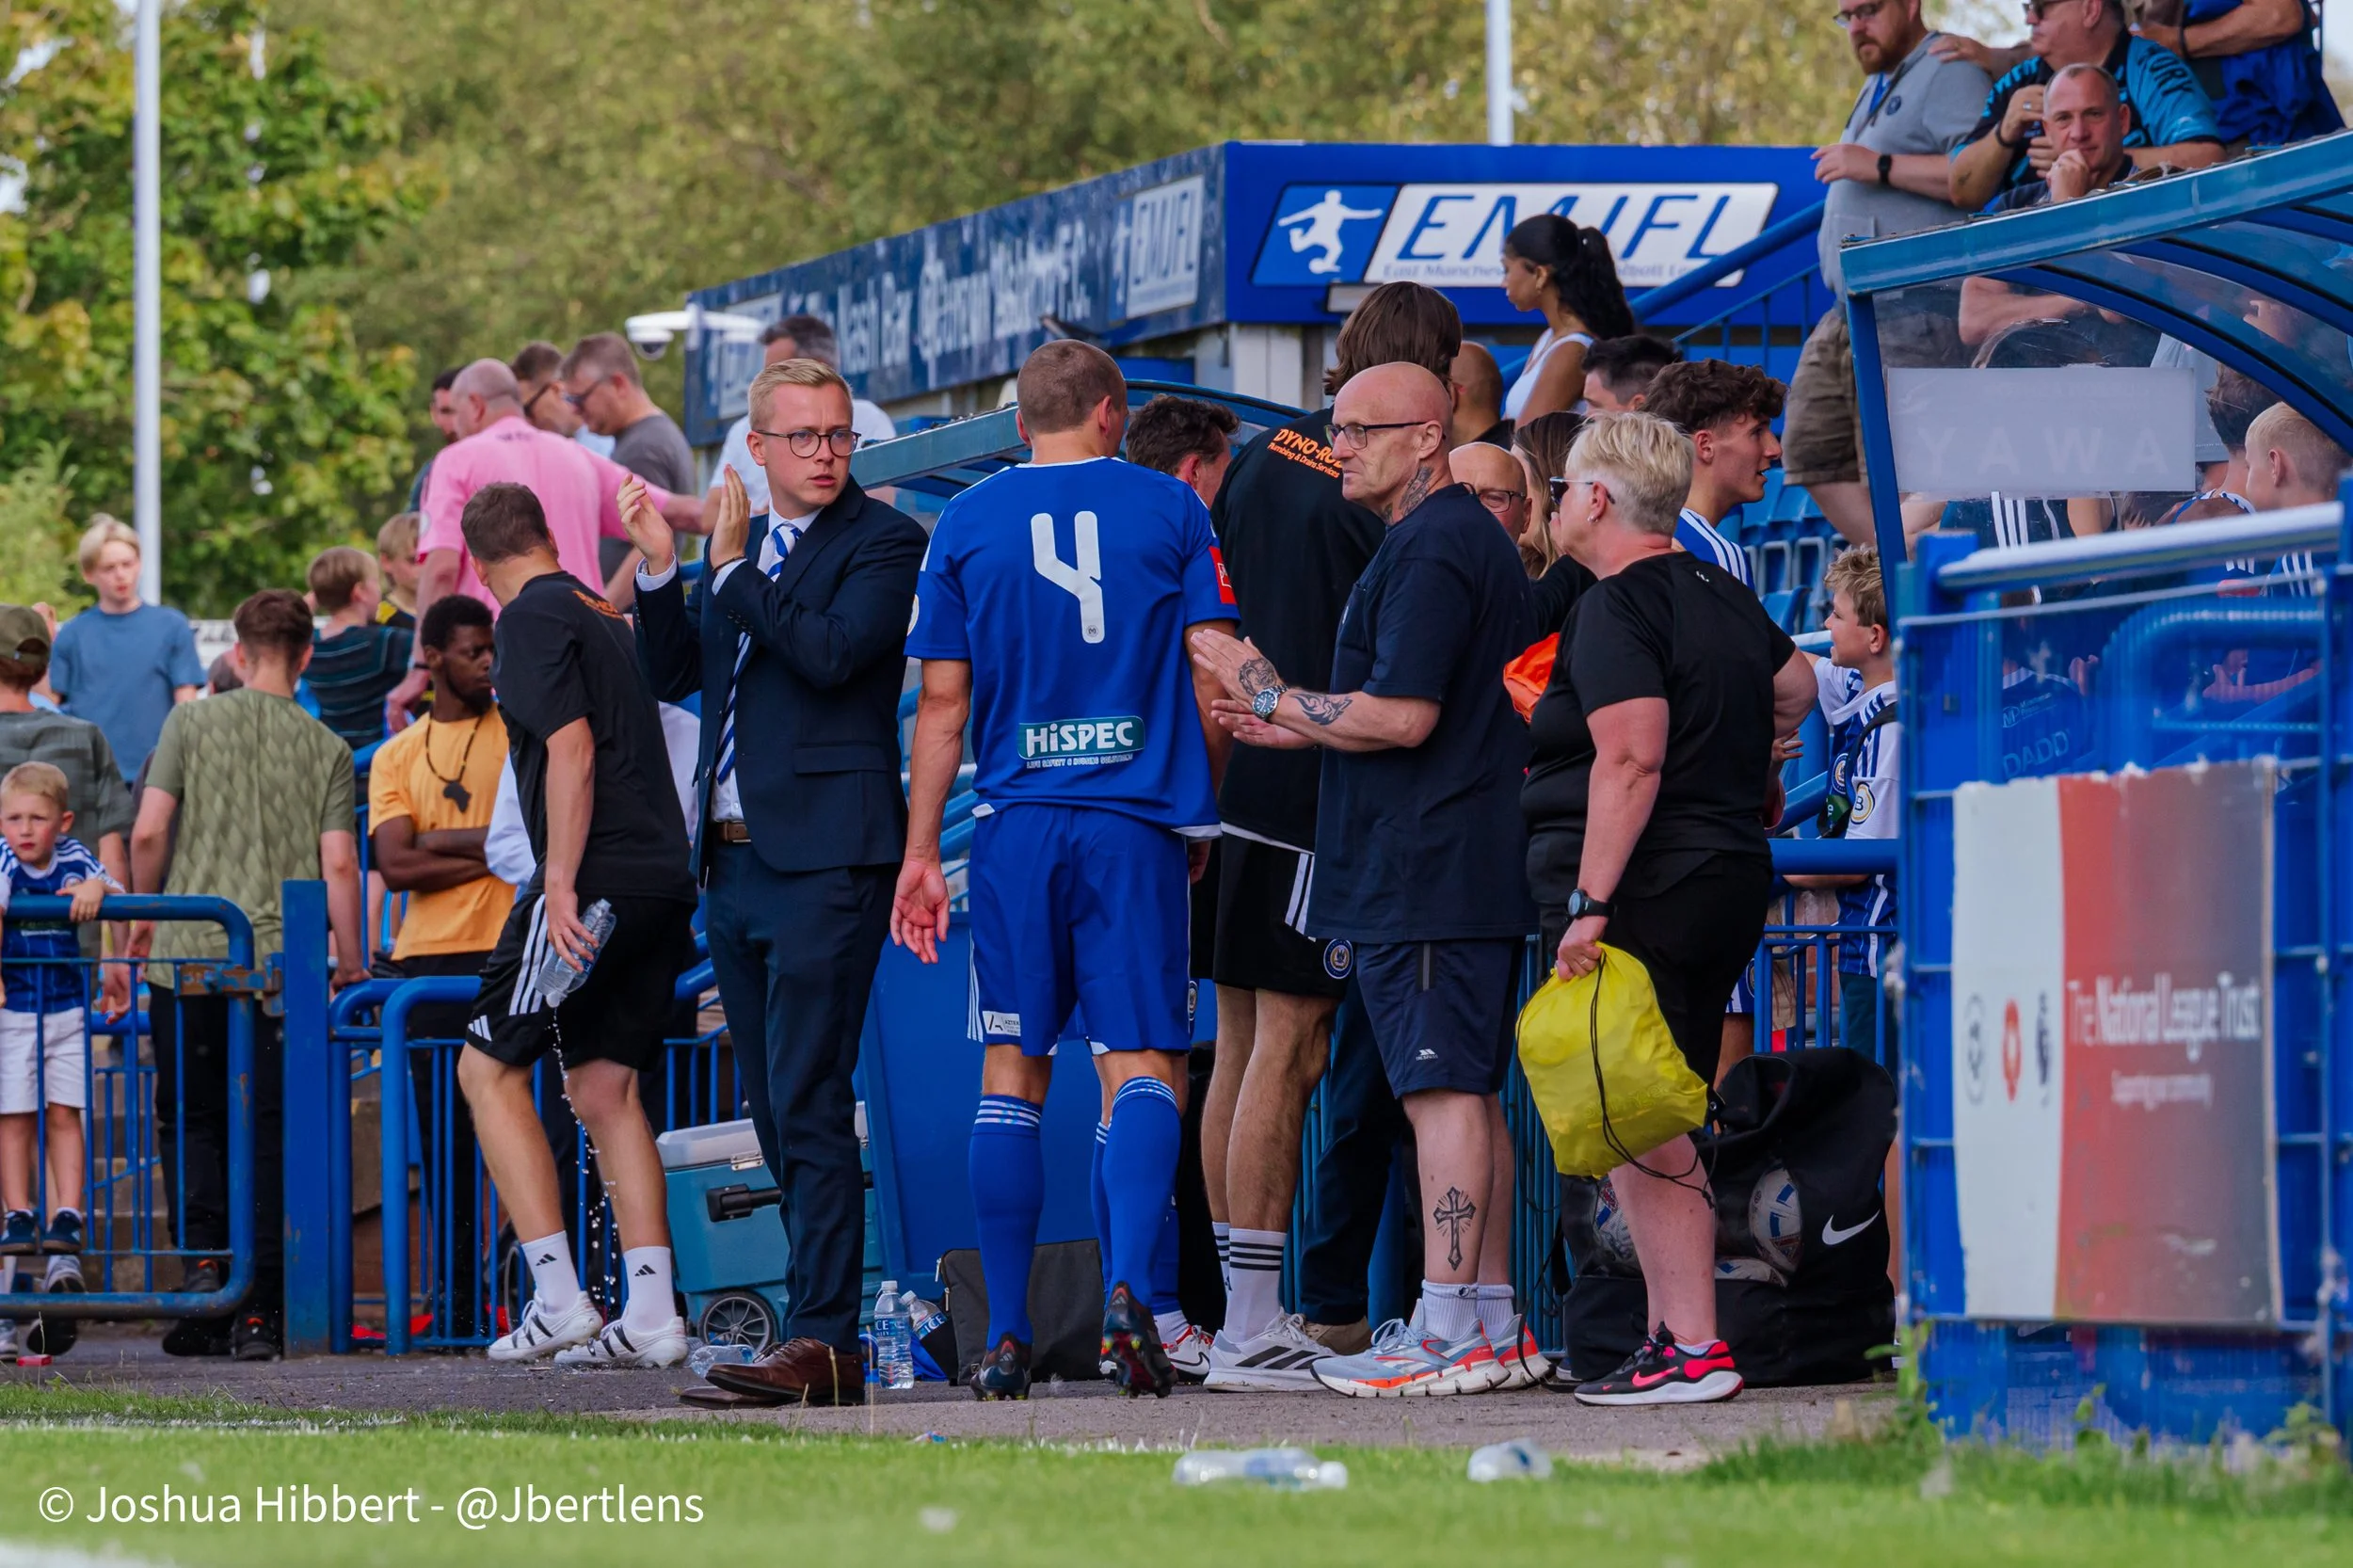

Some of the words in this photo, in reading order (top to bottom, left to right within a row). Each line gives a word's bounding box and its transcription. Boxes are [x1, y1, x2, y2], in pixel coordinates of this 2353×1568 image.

[1316, 462, 1340, 479] Services
[1031, 510, 1106, 644] 4
[1026, 721, 1134, 758] HiSPEC
[2003, 728, 2071, 779] DADD
[875, 1320, 889, 1331] CE
[924, 1314, 945, 1333] ICE
